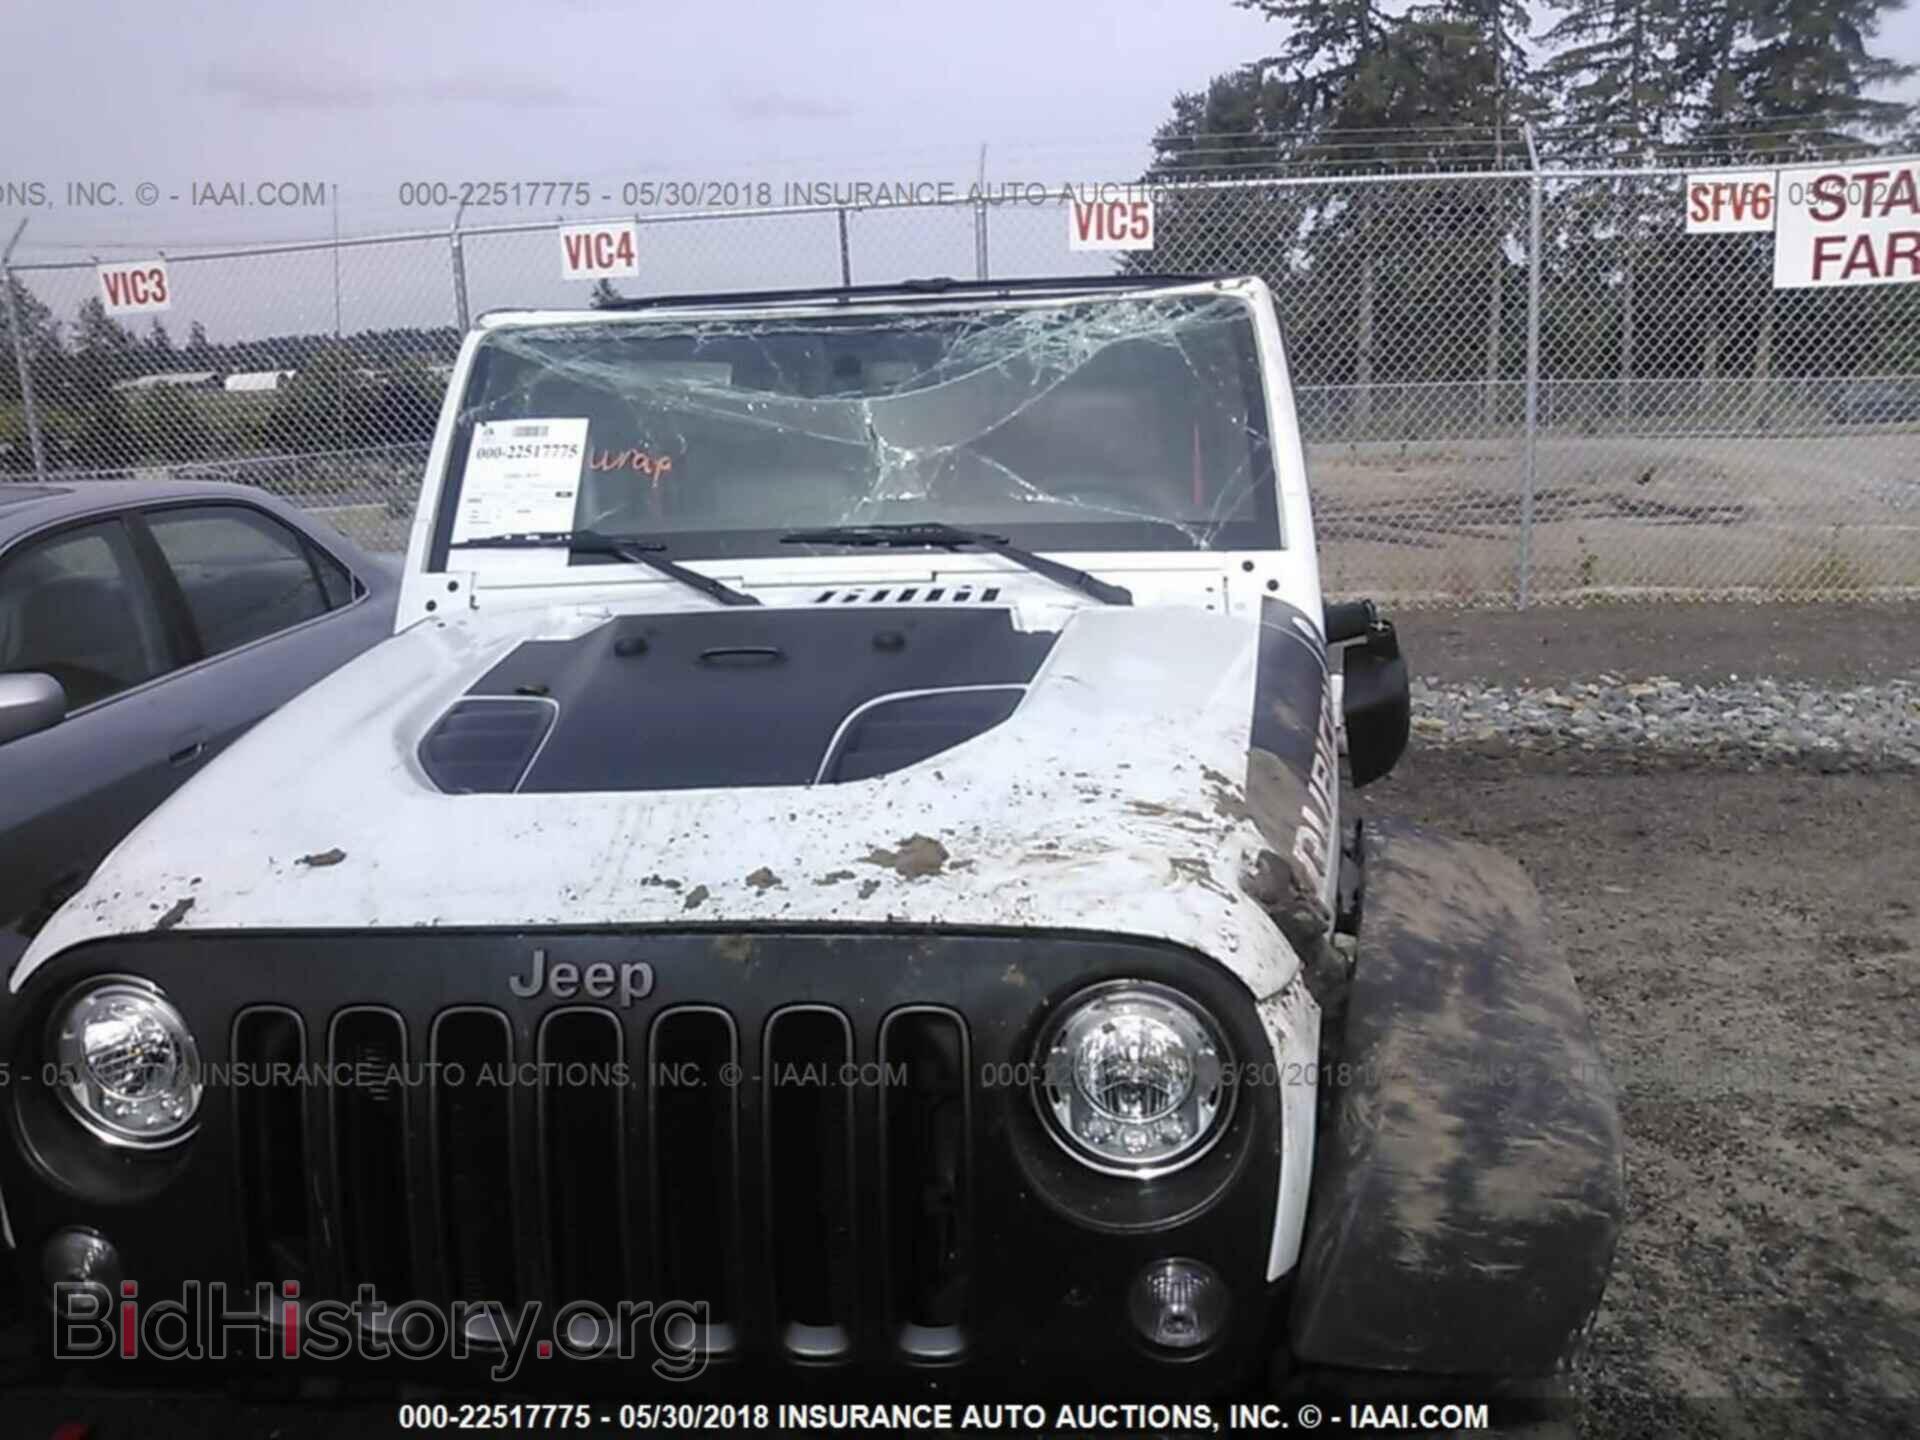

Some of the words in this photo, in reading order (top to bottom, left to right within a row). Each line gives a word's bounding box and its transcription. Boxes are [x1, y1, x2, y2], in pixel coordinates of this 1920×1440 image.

[1074, 201, 1150, 242] VIC5
[1691, 182, 1772, 223] SFV6
[564, 231, 635, 270] VIC4
[103, 268, 166, 306] VIC3
[476, 443, 578, 460] 000-22517775
[509, 949, 653, 1007] Jeep
